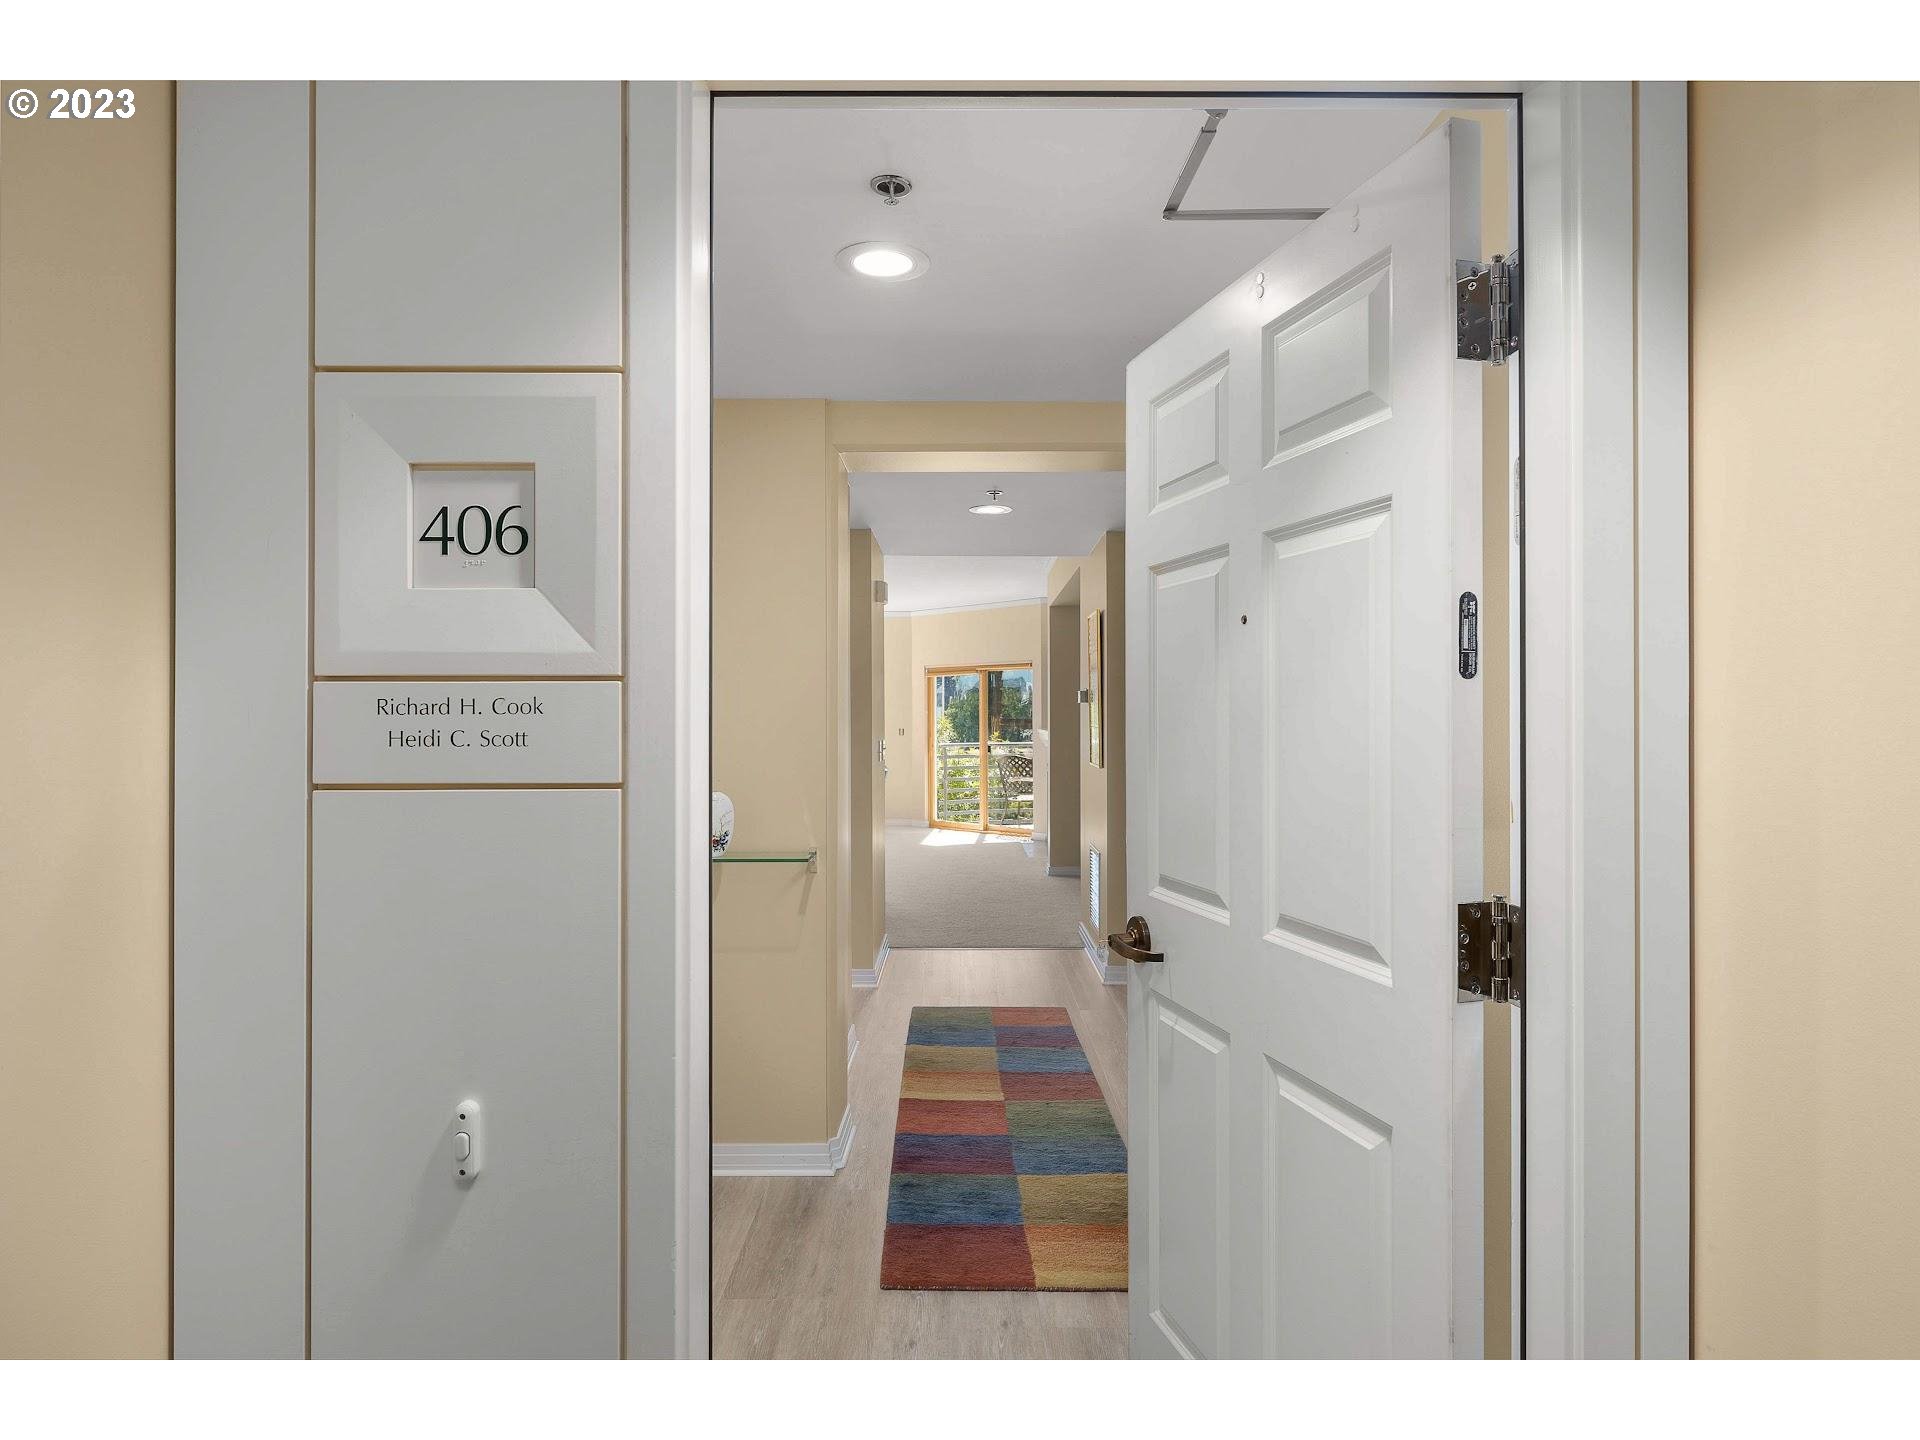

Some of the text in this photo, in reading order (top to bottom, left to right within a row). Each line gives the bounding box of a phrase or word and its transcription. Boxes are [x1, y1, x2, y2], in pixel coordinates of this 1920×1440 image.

[418, 504, 529, 556] 406
[376, 696, 544, 716] Richard H. Cook
[387, 729, 529, 748] Heidi C. Scott
